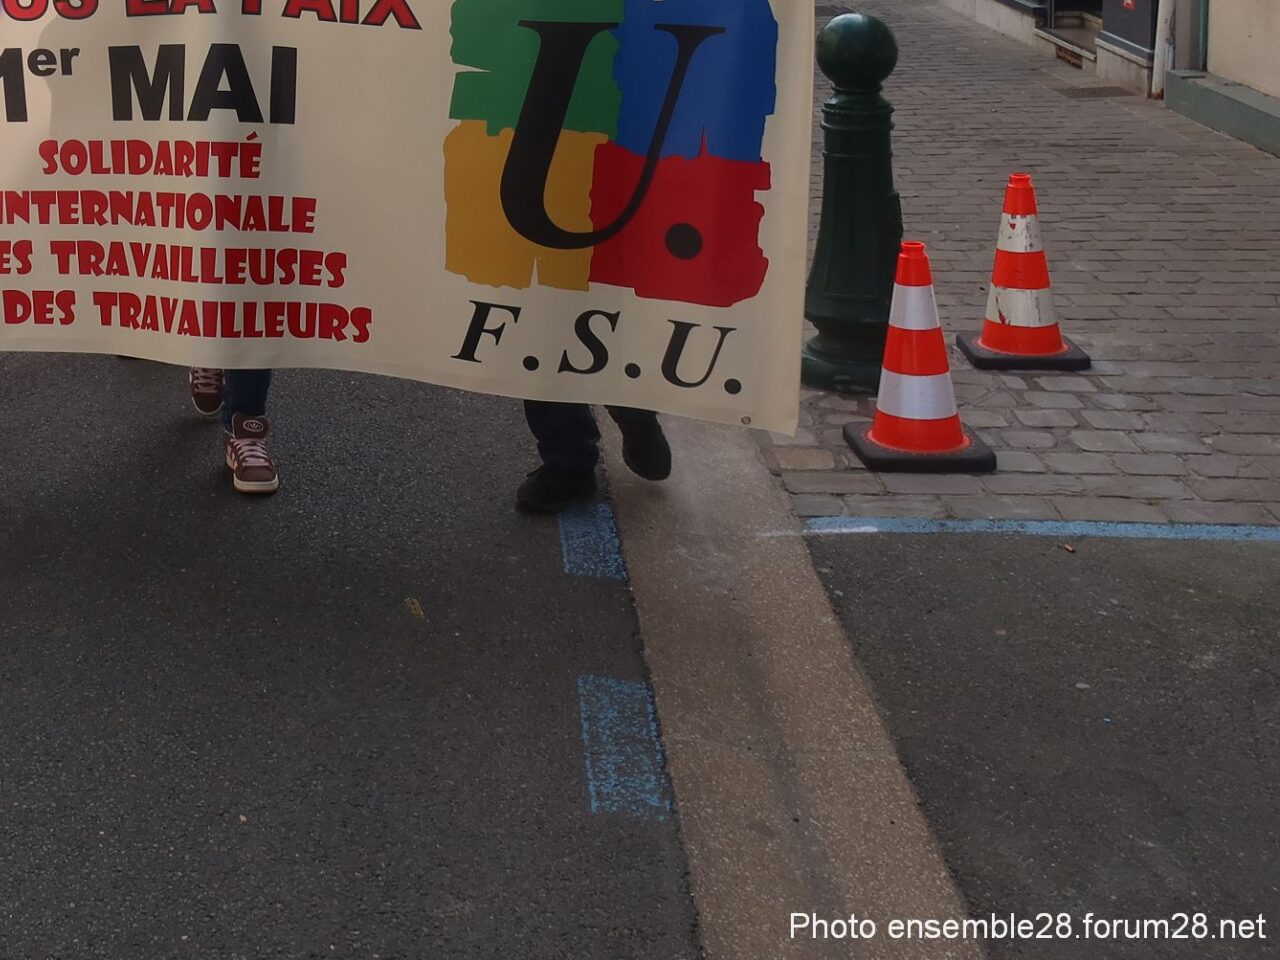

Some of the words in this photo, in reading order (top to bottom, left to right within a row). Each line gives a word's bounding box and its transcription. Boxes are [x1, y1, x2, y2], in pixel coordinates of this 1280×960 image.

[108, 43, 298, 124] MAI
[38, 132, 263, 179] SOLIDARITÉ
[50, 241, 348, 288] TRAVAILLEUSES
[2, 290, 76, 325] DES
[92, 291, 373, 344] TRAVAILLEURS
[451, 300, 743, 395] F.S.U.
